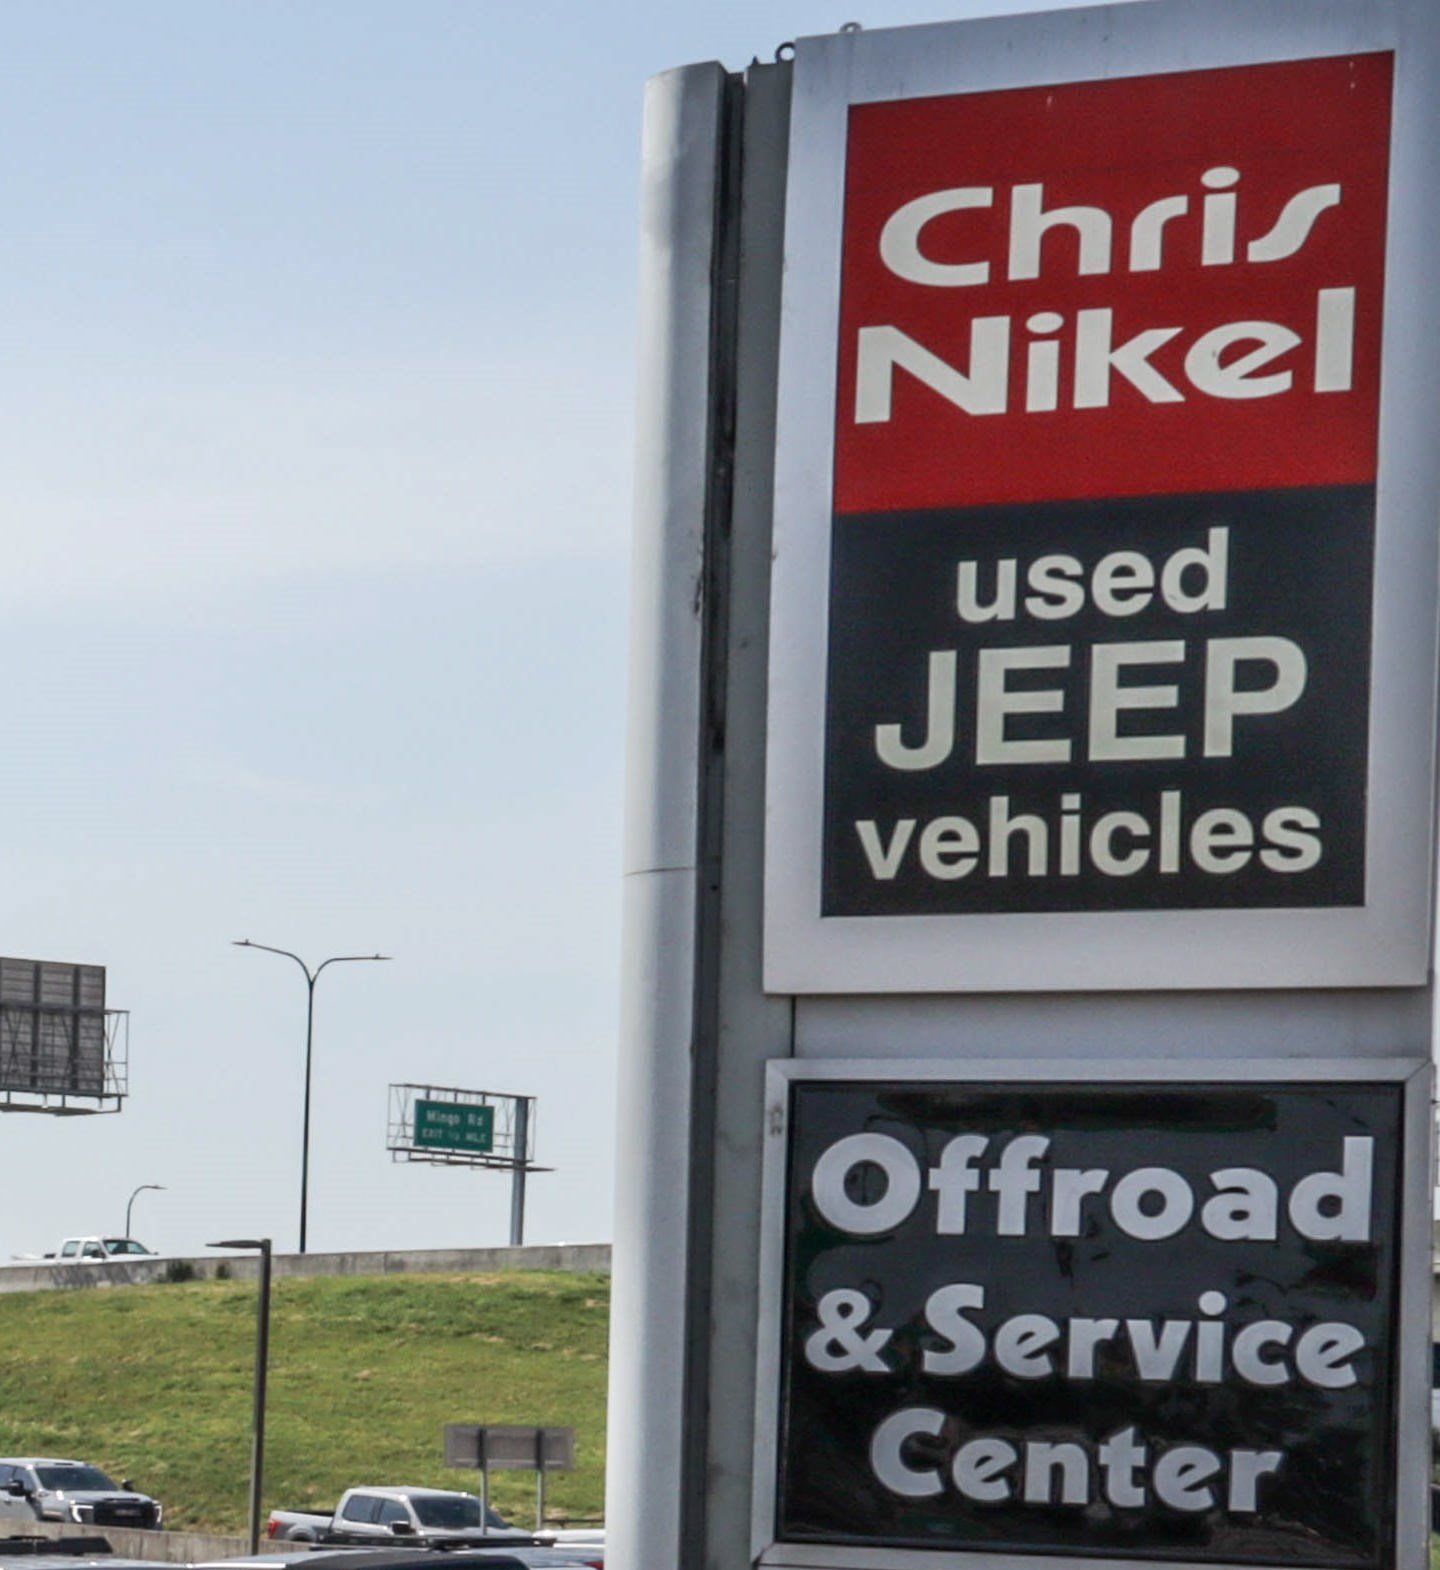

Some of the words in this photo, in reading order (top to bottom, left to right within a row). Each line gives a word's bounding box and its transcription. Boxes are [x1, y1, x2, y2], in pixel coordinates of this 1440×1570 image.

[879, 166, 1342, 288] Chris
[853, 286, 1355, 426] Nikel
[957, 527, 1229, 623] used
[874, 636, 1308, 772] JEEP
[855, 790, 1321, 882] vehicles
[811, 1132, 1375, 1242] Offroad
[805, 1288, 892, 1374] &
[922, 1283, 1365, 1389] Service
[871, 1407, 1282, 1513] Center
